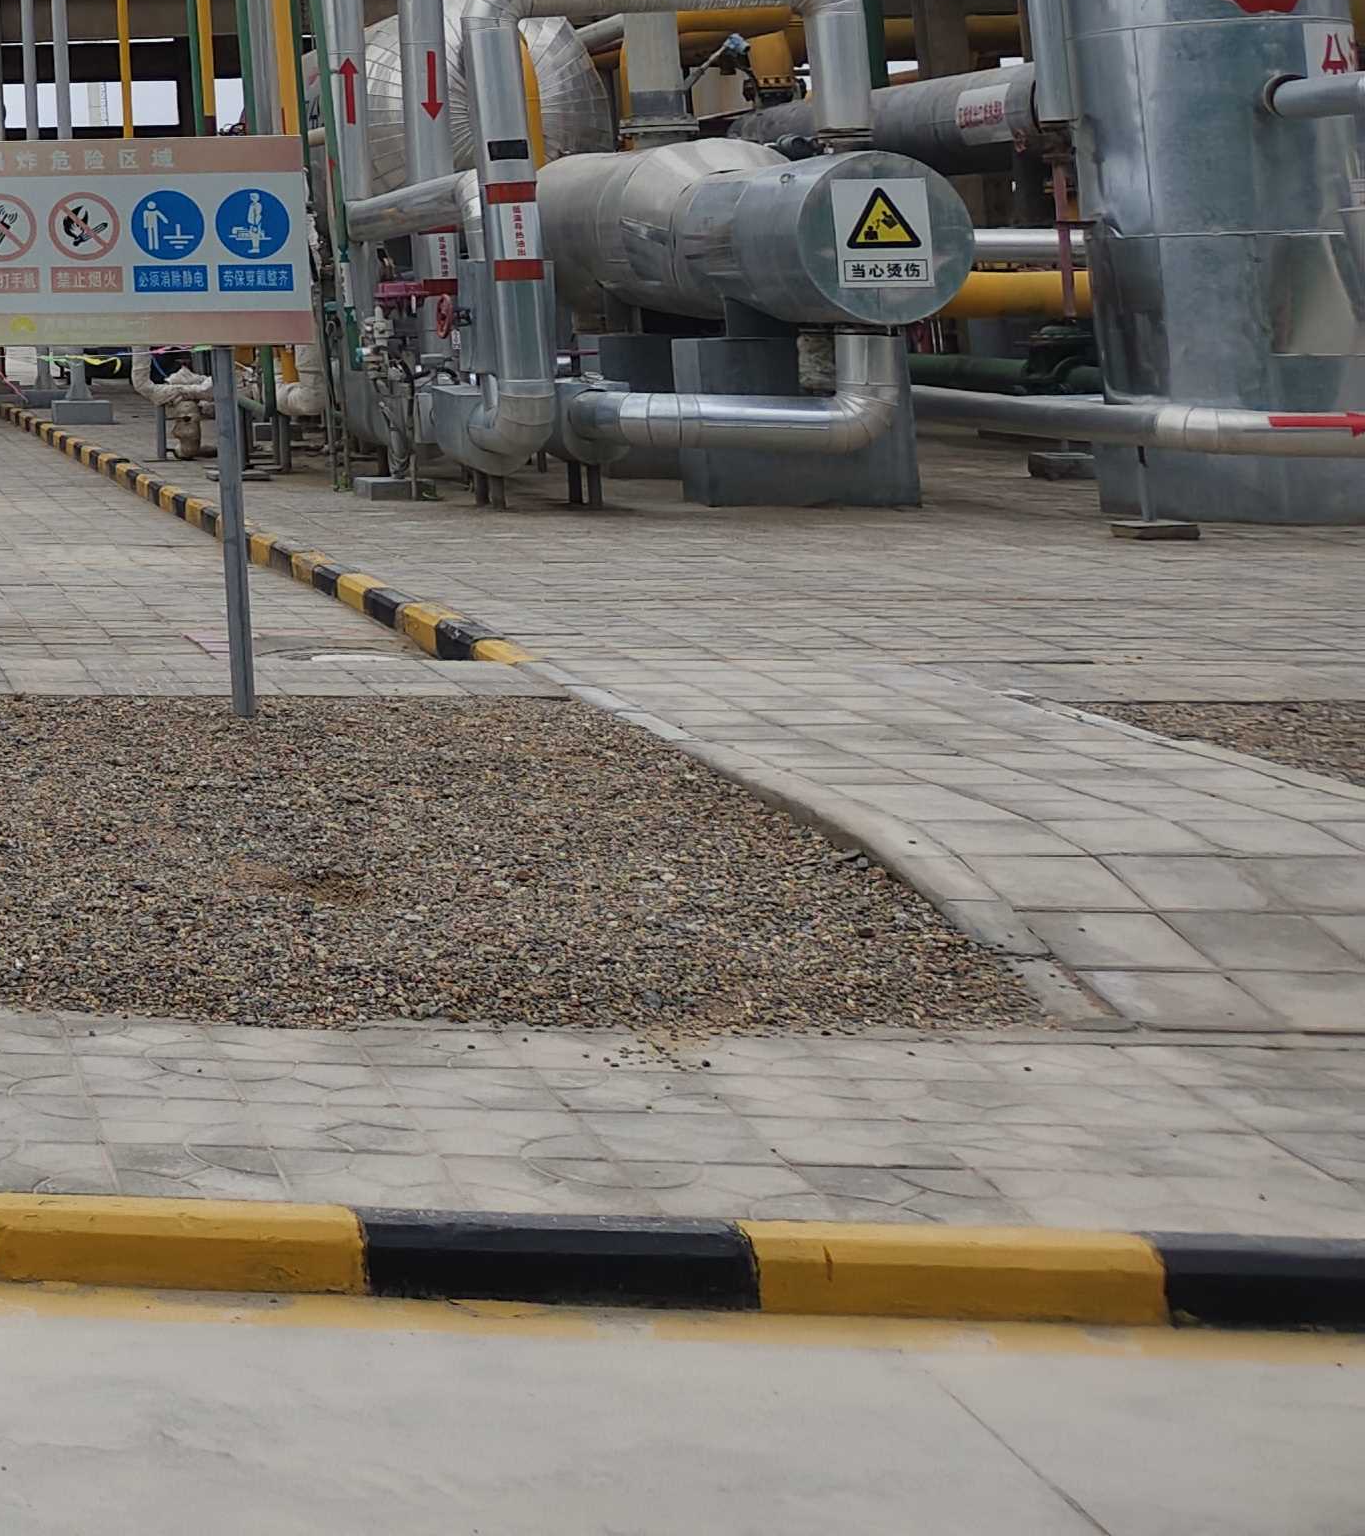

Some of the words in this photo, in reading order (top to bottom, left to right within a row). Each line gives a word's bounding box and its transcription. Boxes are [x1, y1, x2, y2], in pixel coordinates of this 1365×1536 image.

[138, 270, 205, 289] 必须消除静电
[222, 269, 289, 288] 劳保穿戴整齐
[851, 263, 921, 278] 当心烫伤
[57, 271, 118, 289] 禁止烟火
